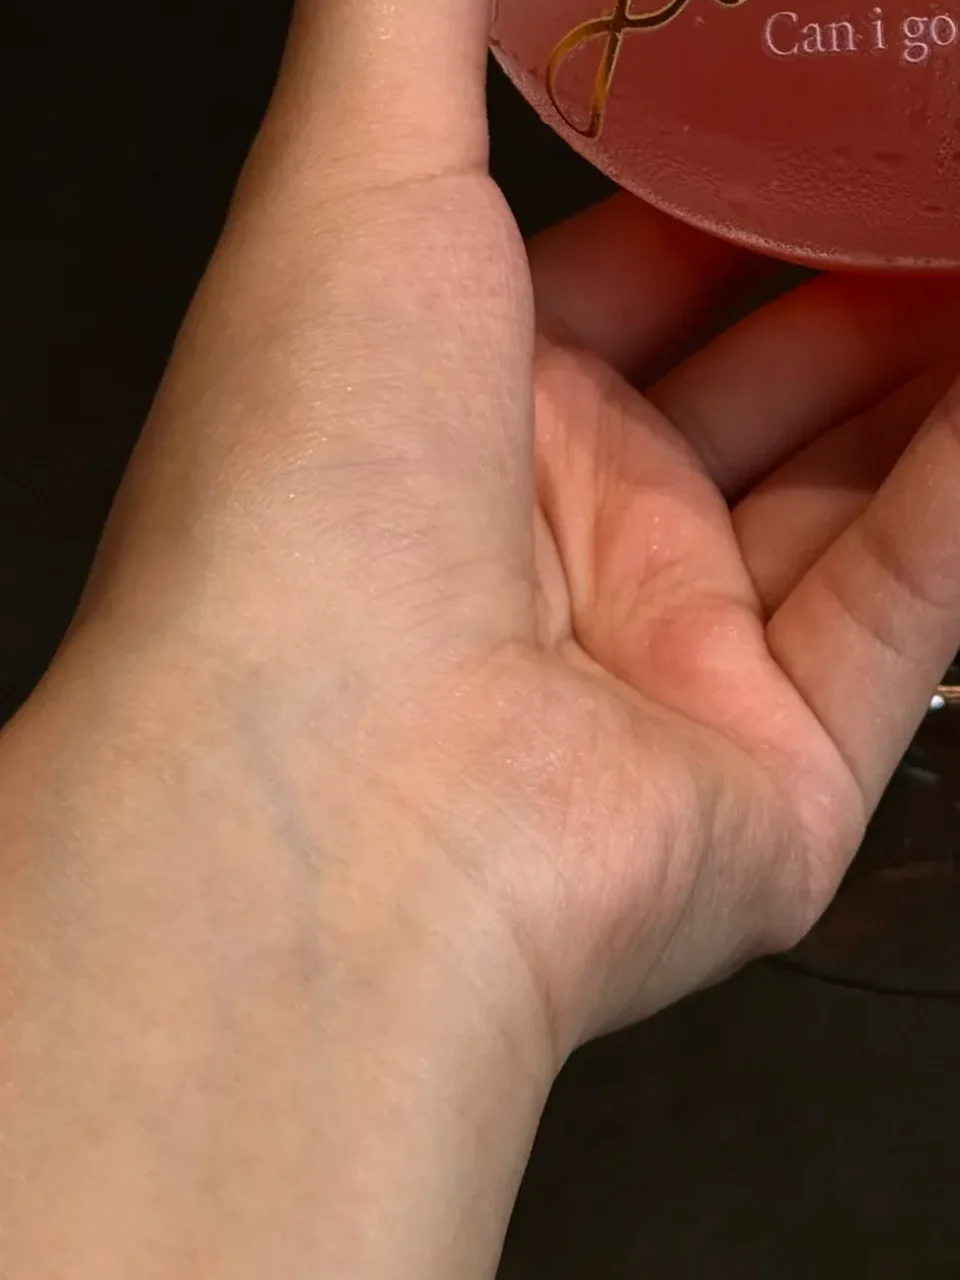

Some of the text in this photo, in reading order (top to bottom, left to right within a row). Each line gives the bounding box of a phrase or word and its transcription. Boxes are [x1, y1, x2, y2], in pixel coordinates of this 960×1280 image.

[764, 11, 858, 56] Can
[871, 6, 886, 51] i
[901, 14, 958, 63] go
